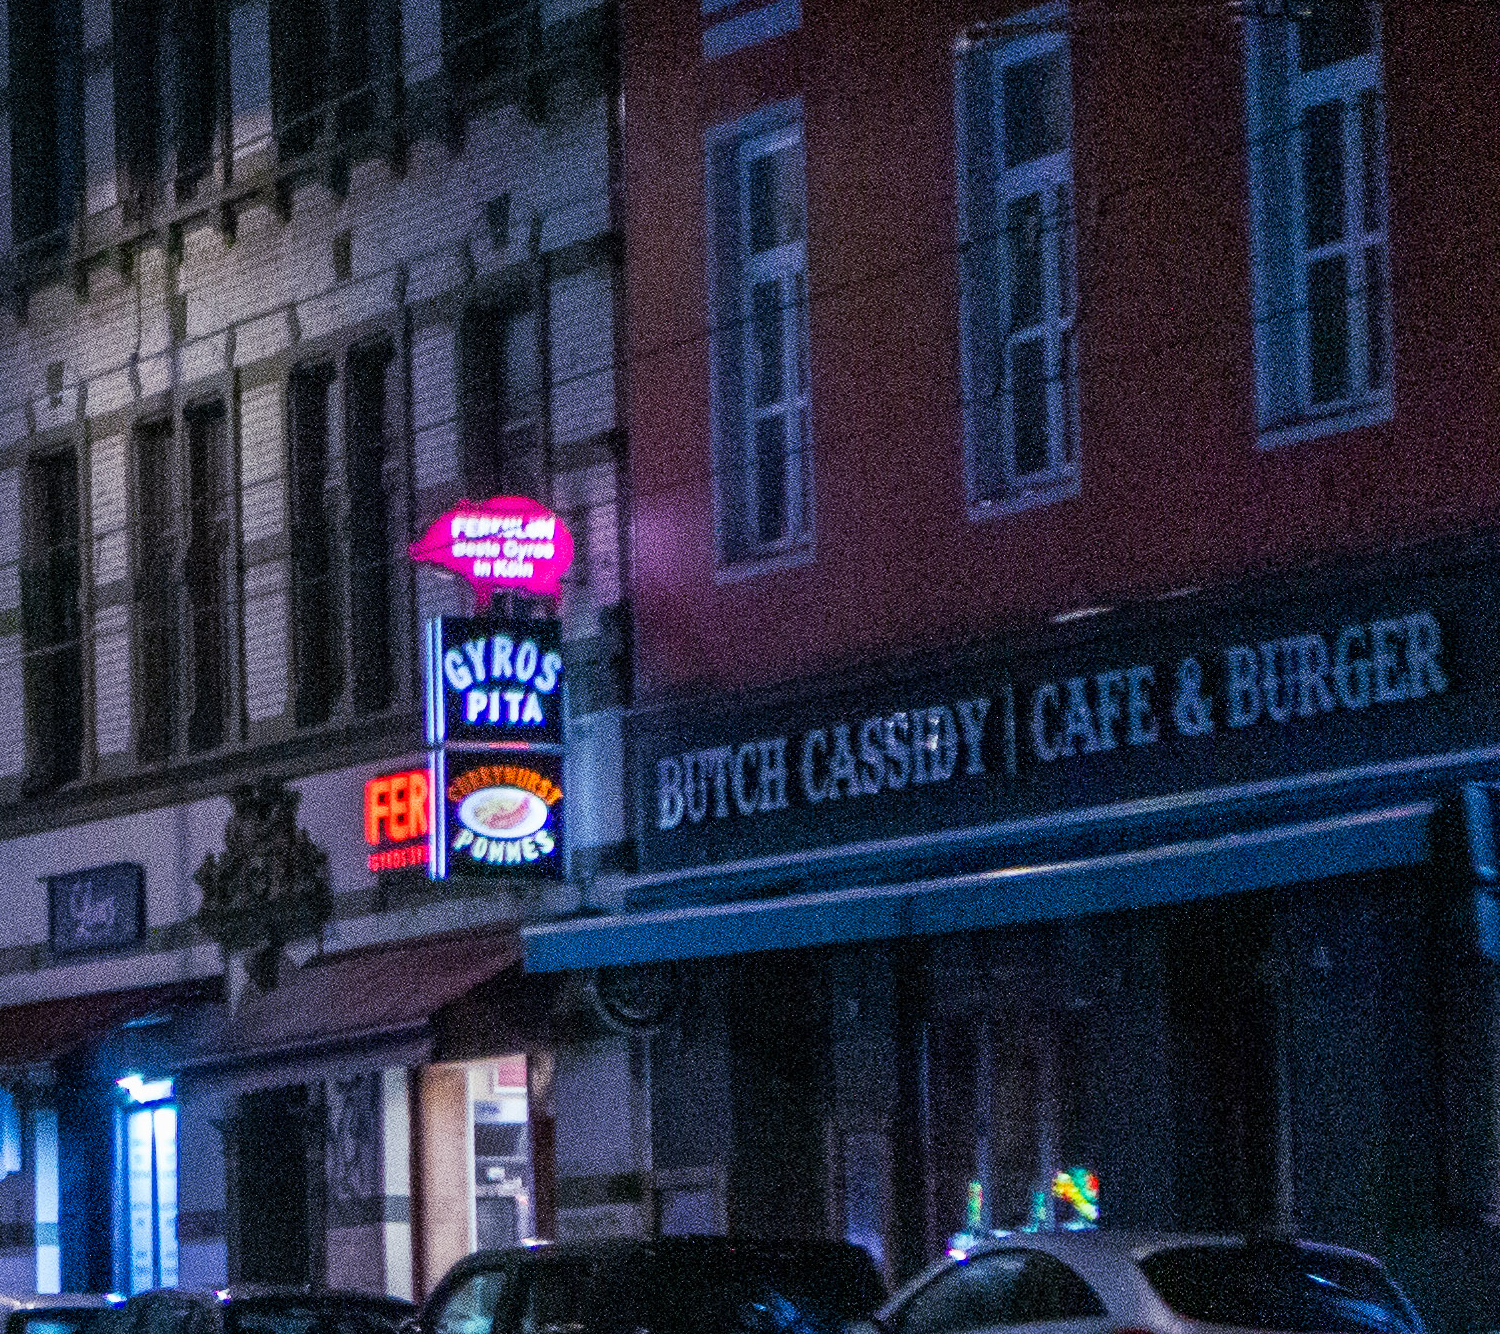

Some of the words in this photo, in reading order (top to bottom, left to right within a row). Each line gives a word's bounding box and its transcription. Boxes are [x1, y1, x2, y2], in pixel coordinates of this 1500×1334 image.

[444, 633, 563, 694] GYROS
[466, 689, 546, 725] PITA
[656, 738, 791, 832] BUTCH
[801, 697, 991, 804] CASSIDY
[1030, 666, 1160, 763] CAFE
[1172, 657, 1215, 737] &
[1225, 612, 1449, 731] BURGER
[452, 829, 556, 865] POMMES
